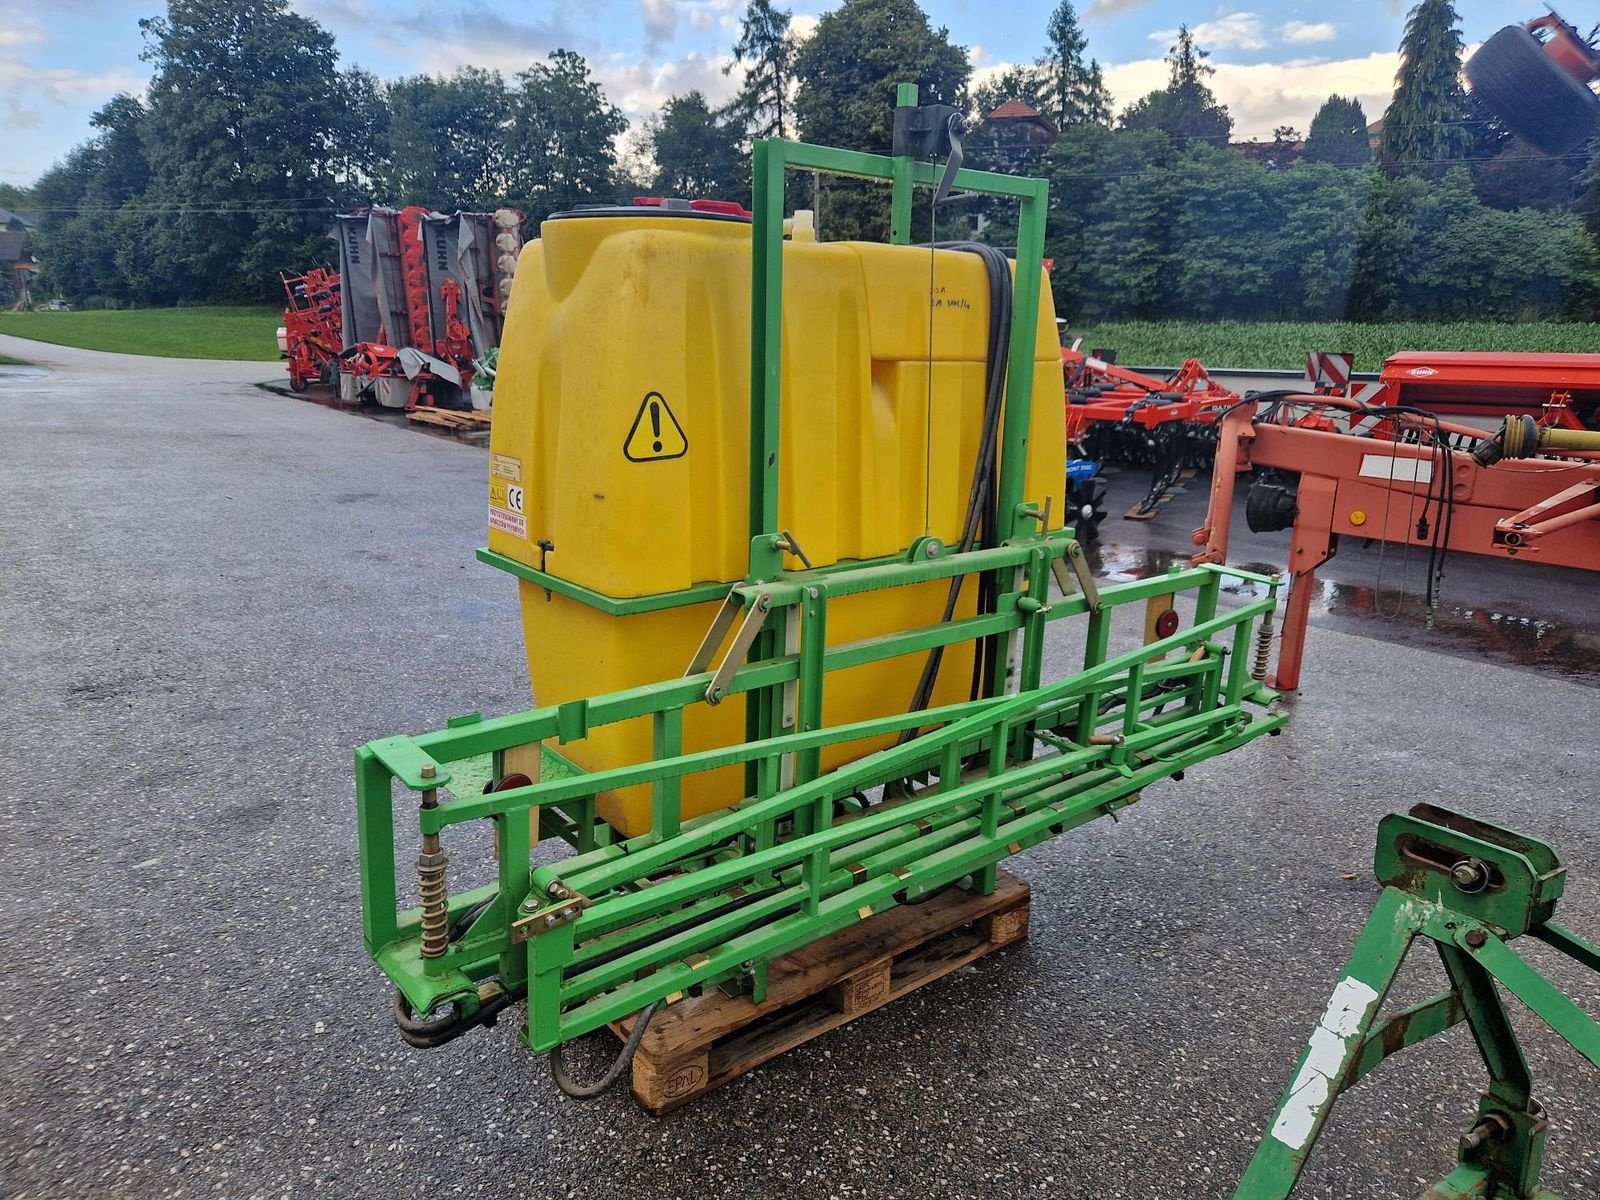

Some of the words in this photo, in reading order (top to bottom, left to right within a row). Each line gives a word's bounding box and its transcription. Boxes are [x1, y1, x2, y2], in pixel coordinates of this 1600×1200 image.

[346, 226, 361, 264] KUHN
[434, 229, 449, 271] KUHN
[1410, 368, 1434, 376] KUHN
[508, 488, 522, 510] CE
